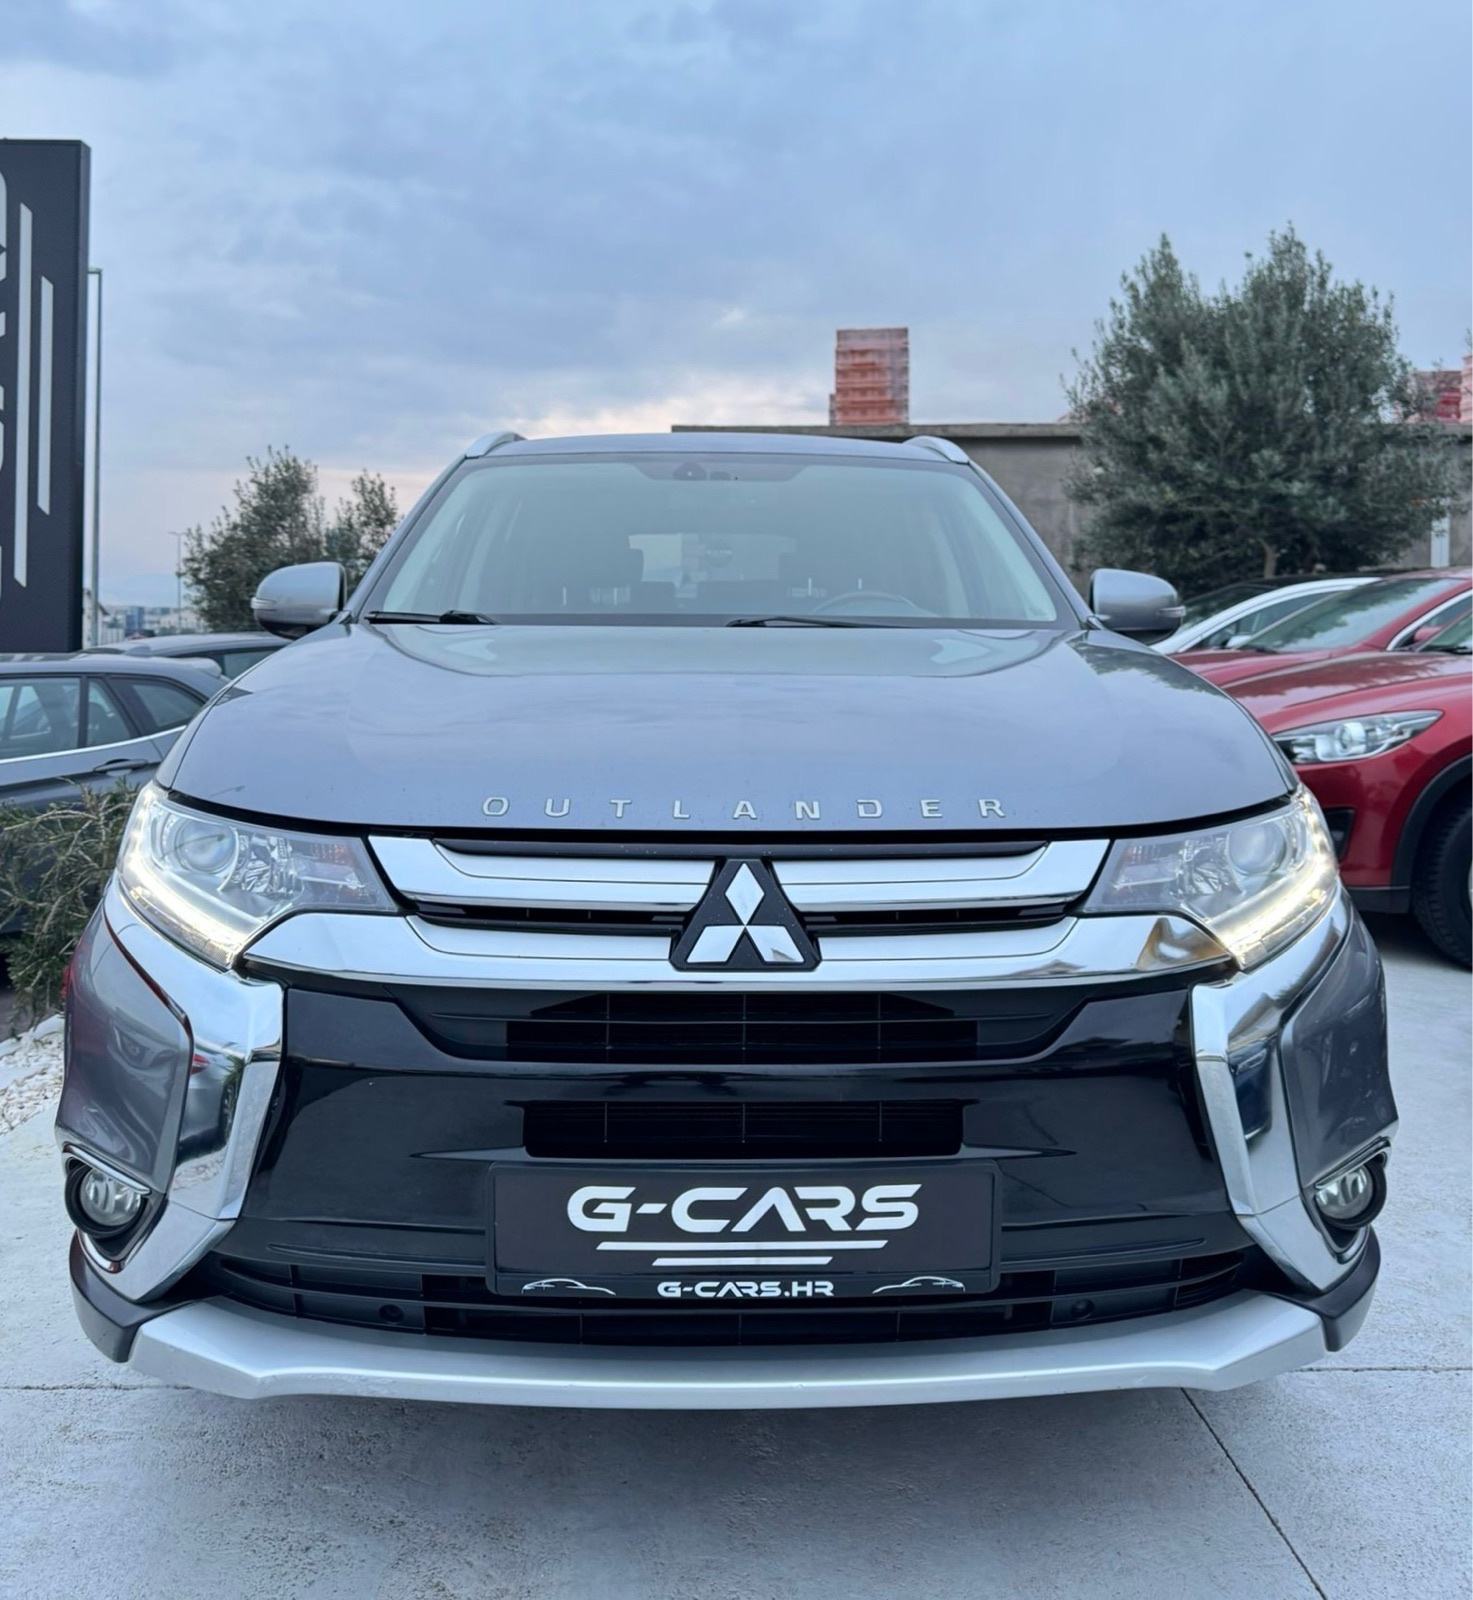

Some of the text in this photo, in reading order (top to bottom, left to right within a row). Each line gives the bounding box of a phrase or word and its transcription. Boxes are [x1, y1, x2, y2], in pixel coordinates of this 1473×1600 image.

[482, 796, 1006, 819] OUTLANDER
[567, 1184, 922, 1233] G-CARS
[657, 1280, 834, 1298] G-CARS.HR
